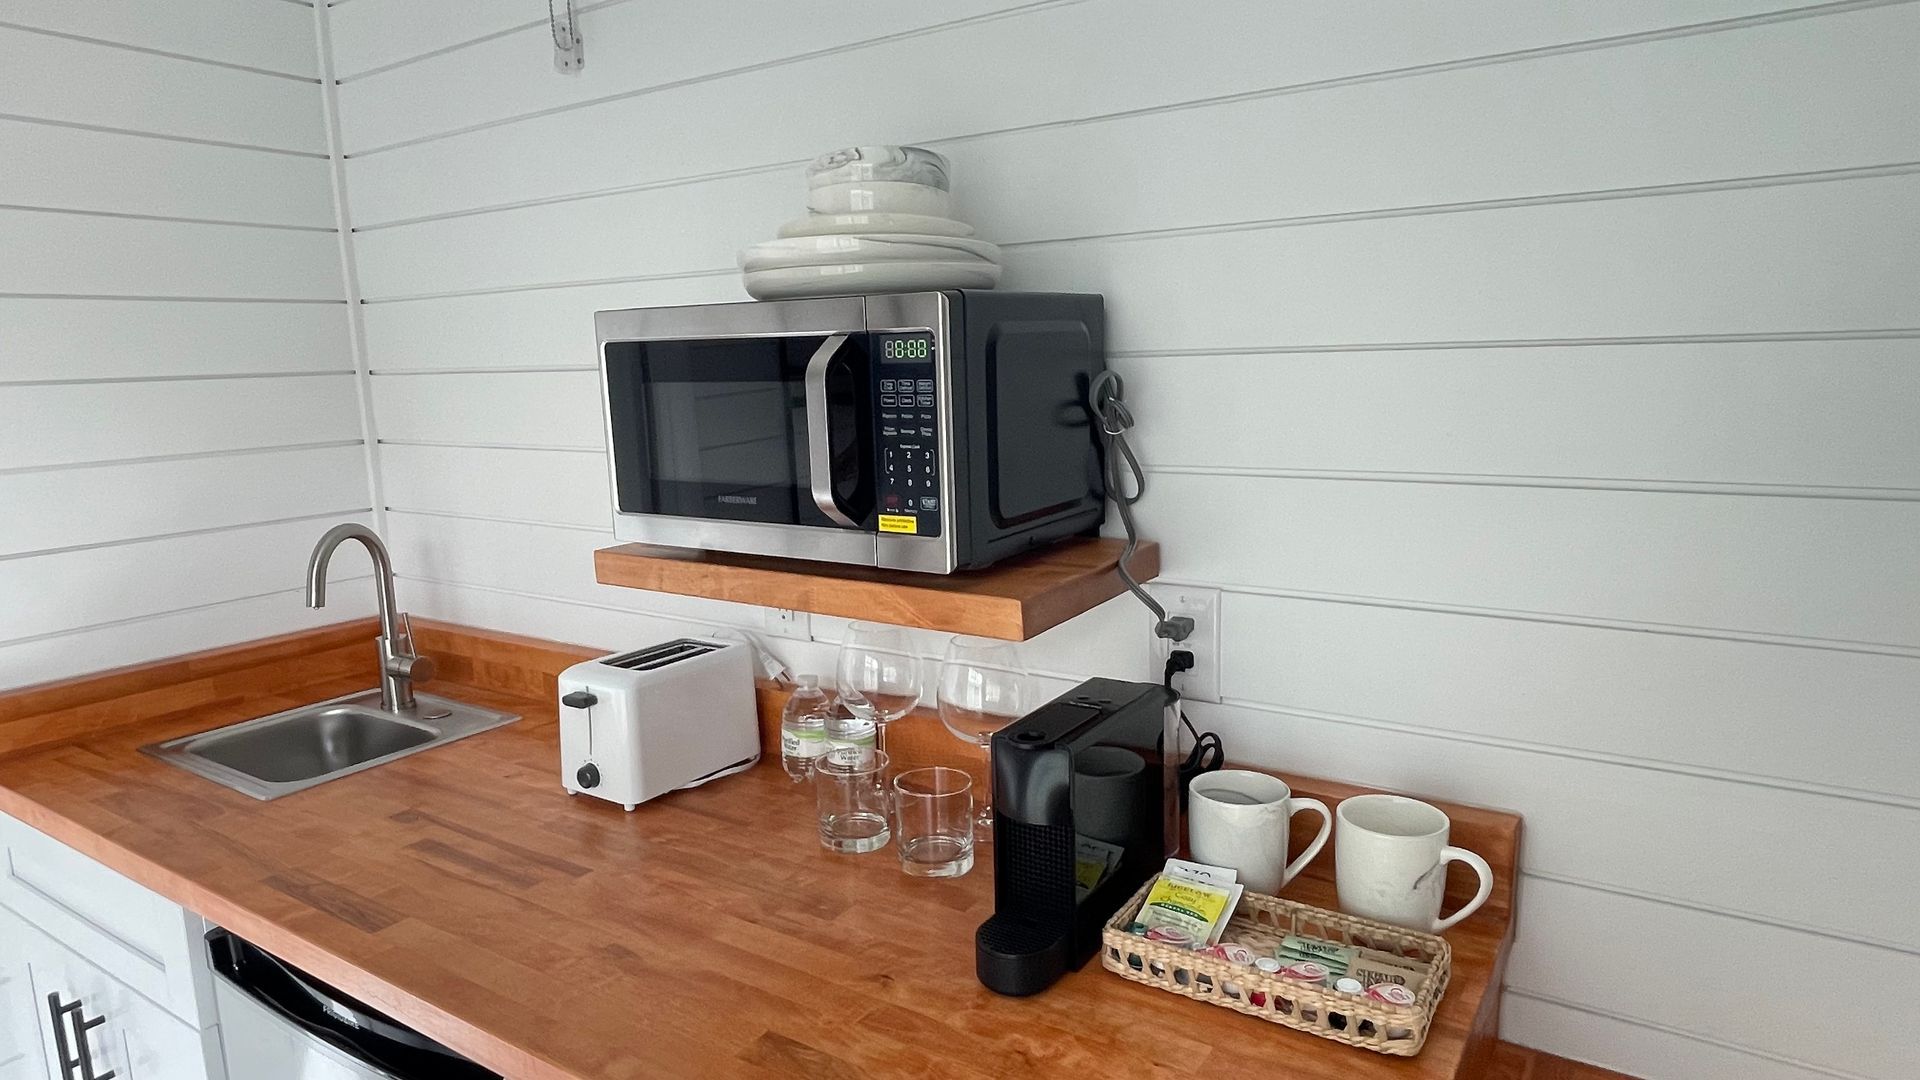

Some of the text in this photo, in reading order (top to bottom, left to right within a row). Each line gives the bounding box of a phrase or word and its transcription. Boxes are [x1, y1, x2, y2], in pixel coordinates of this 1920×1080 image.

[906, 451, 911, 459] 2
[907, 464, 912, 472] 5
[908, 499, 913, 507] 0
